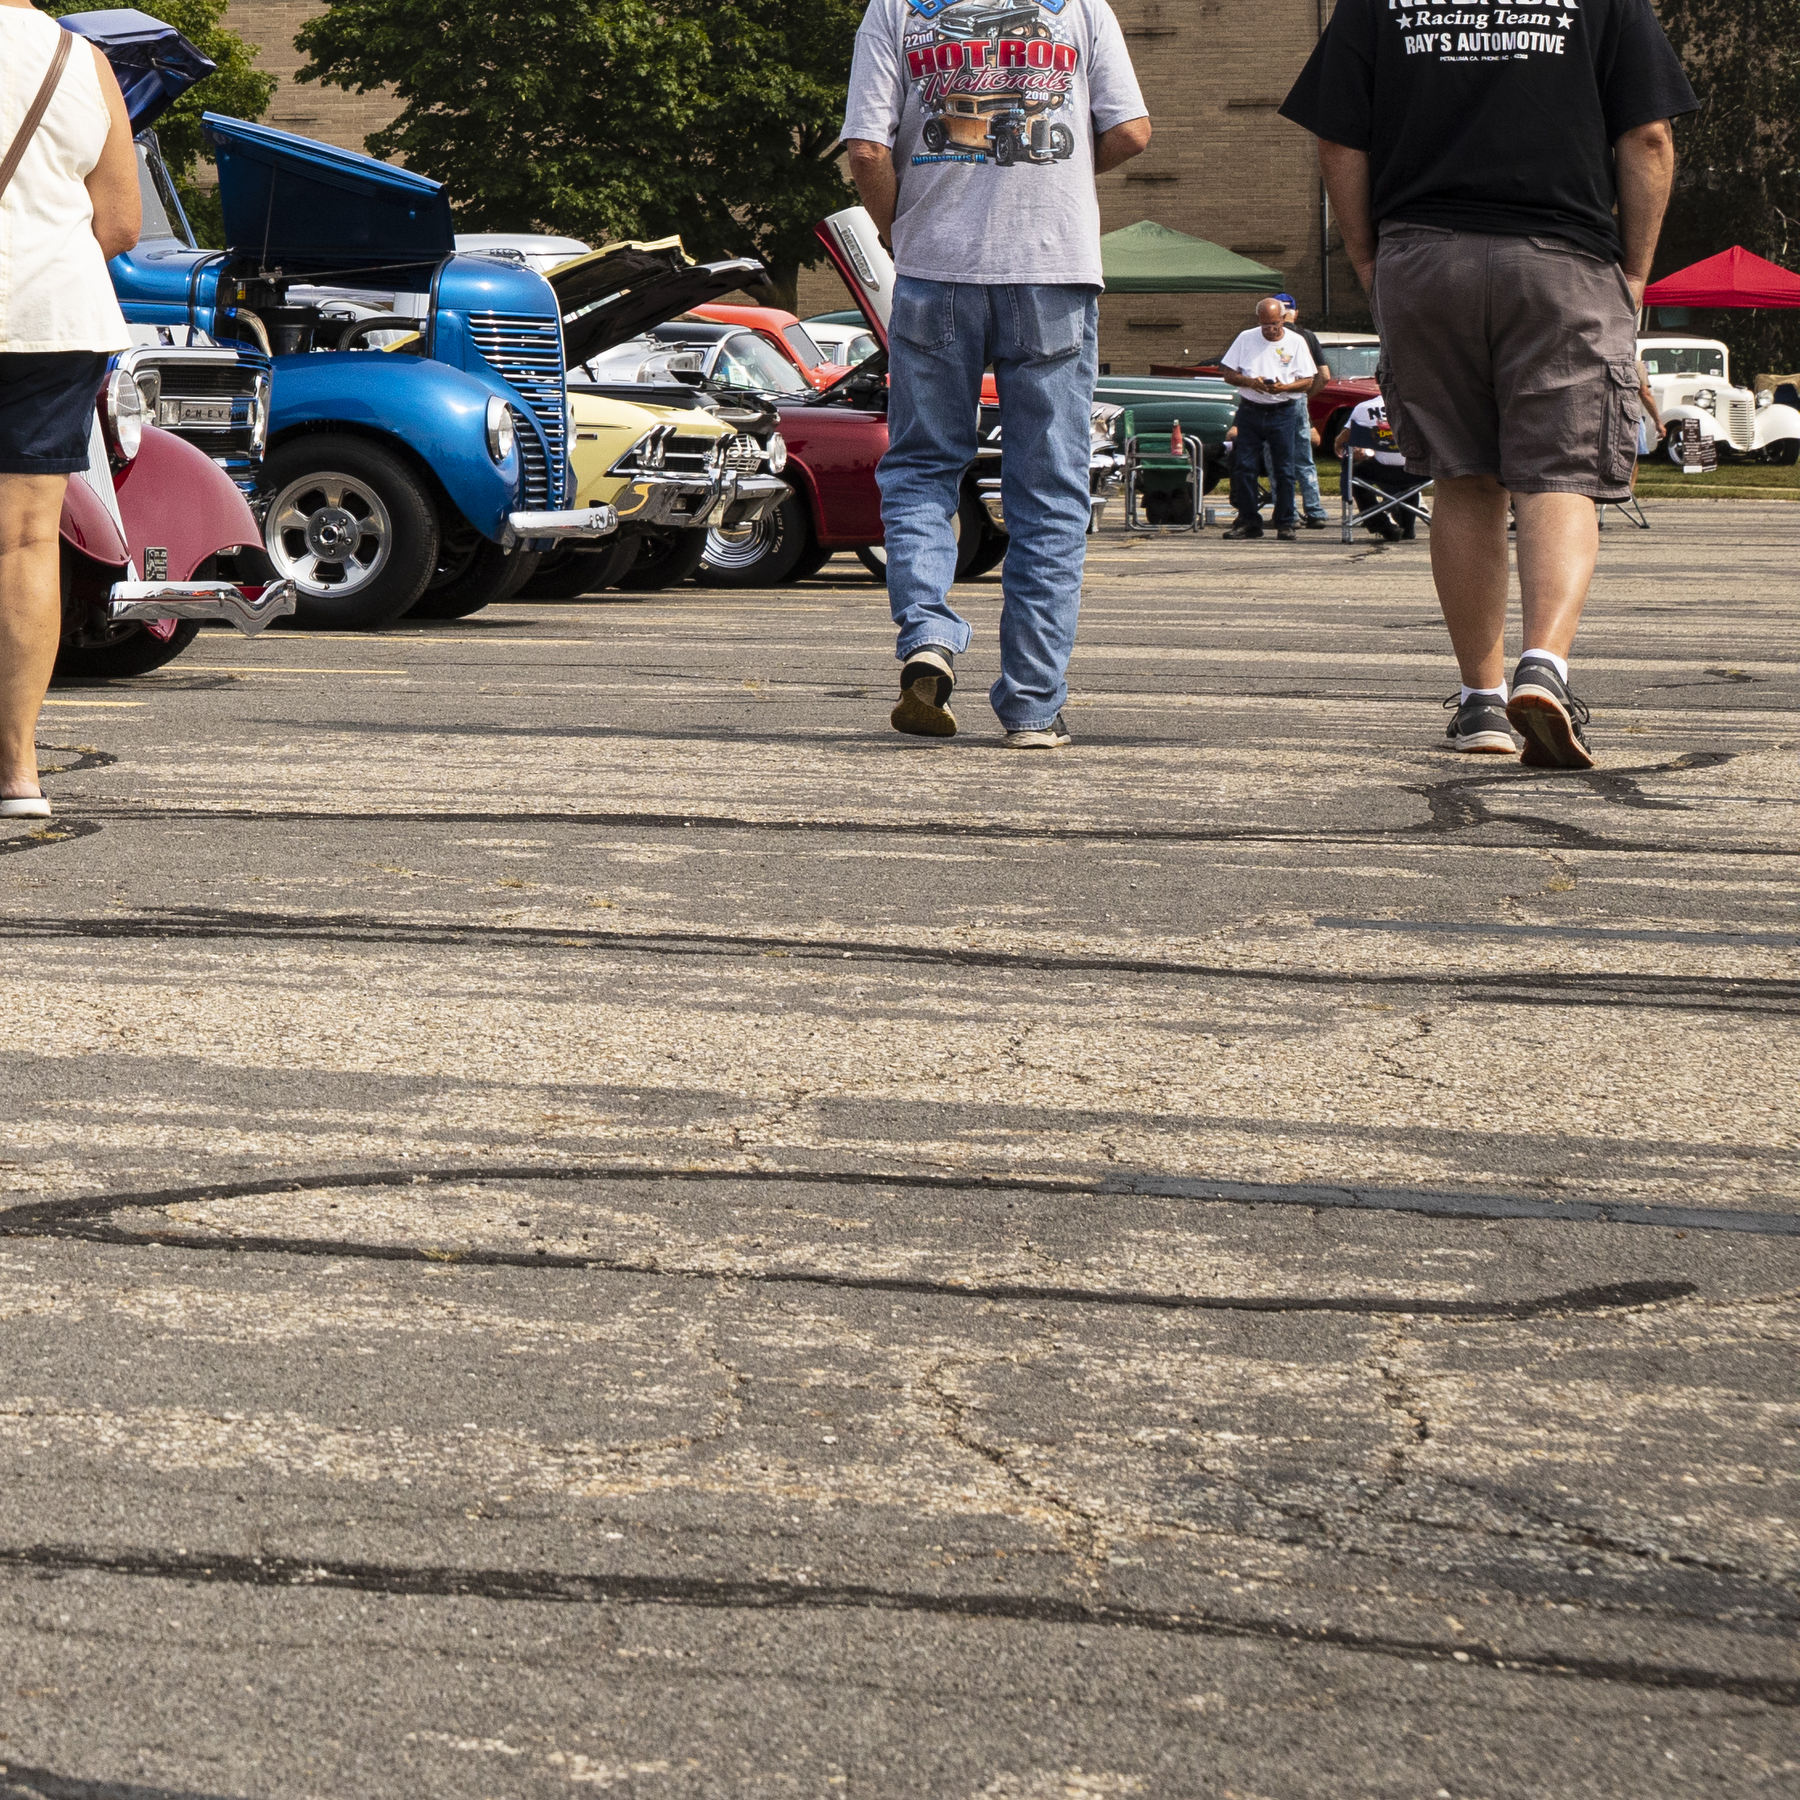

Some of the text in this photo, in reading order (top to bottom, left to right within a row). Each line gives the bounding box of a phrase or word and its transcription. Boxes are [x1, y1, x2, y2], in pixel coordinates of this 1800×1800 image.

[1415, 9, 1551, 30] Racing Team
[904, 29, 935, 49] 22nd
[1404, 30, 1566, 55] RAY'S AUTOMOTIVE
[906, 37, 1078, 81] HOT ROD
[922, 63, 1073, 103] Nationals
[1025, 90, 1050, 101] 2010
